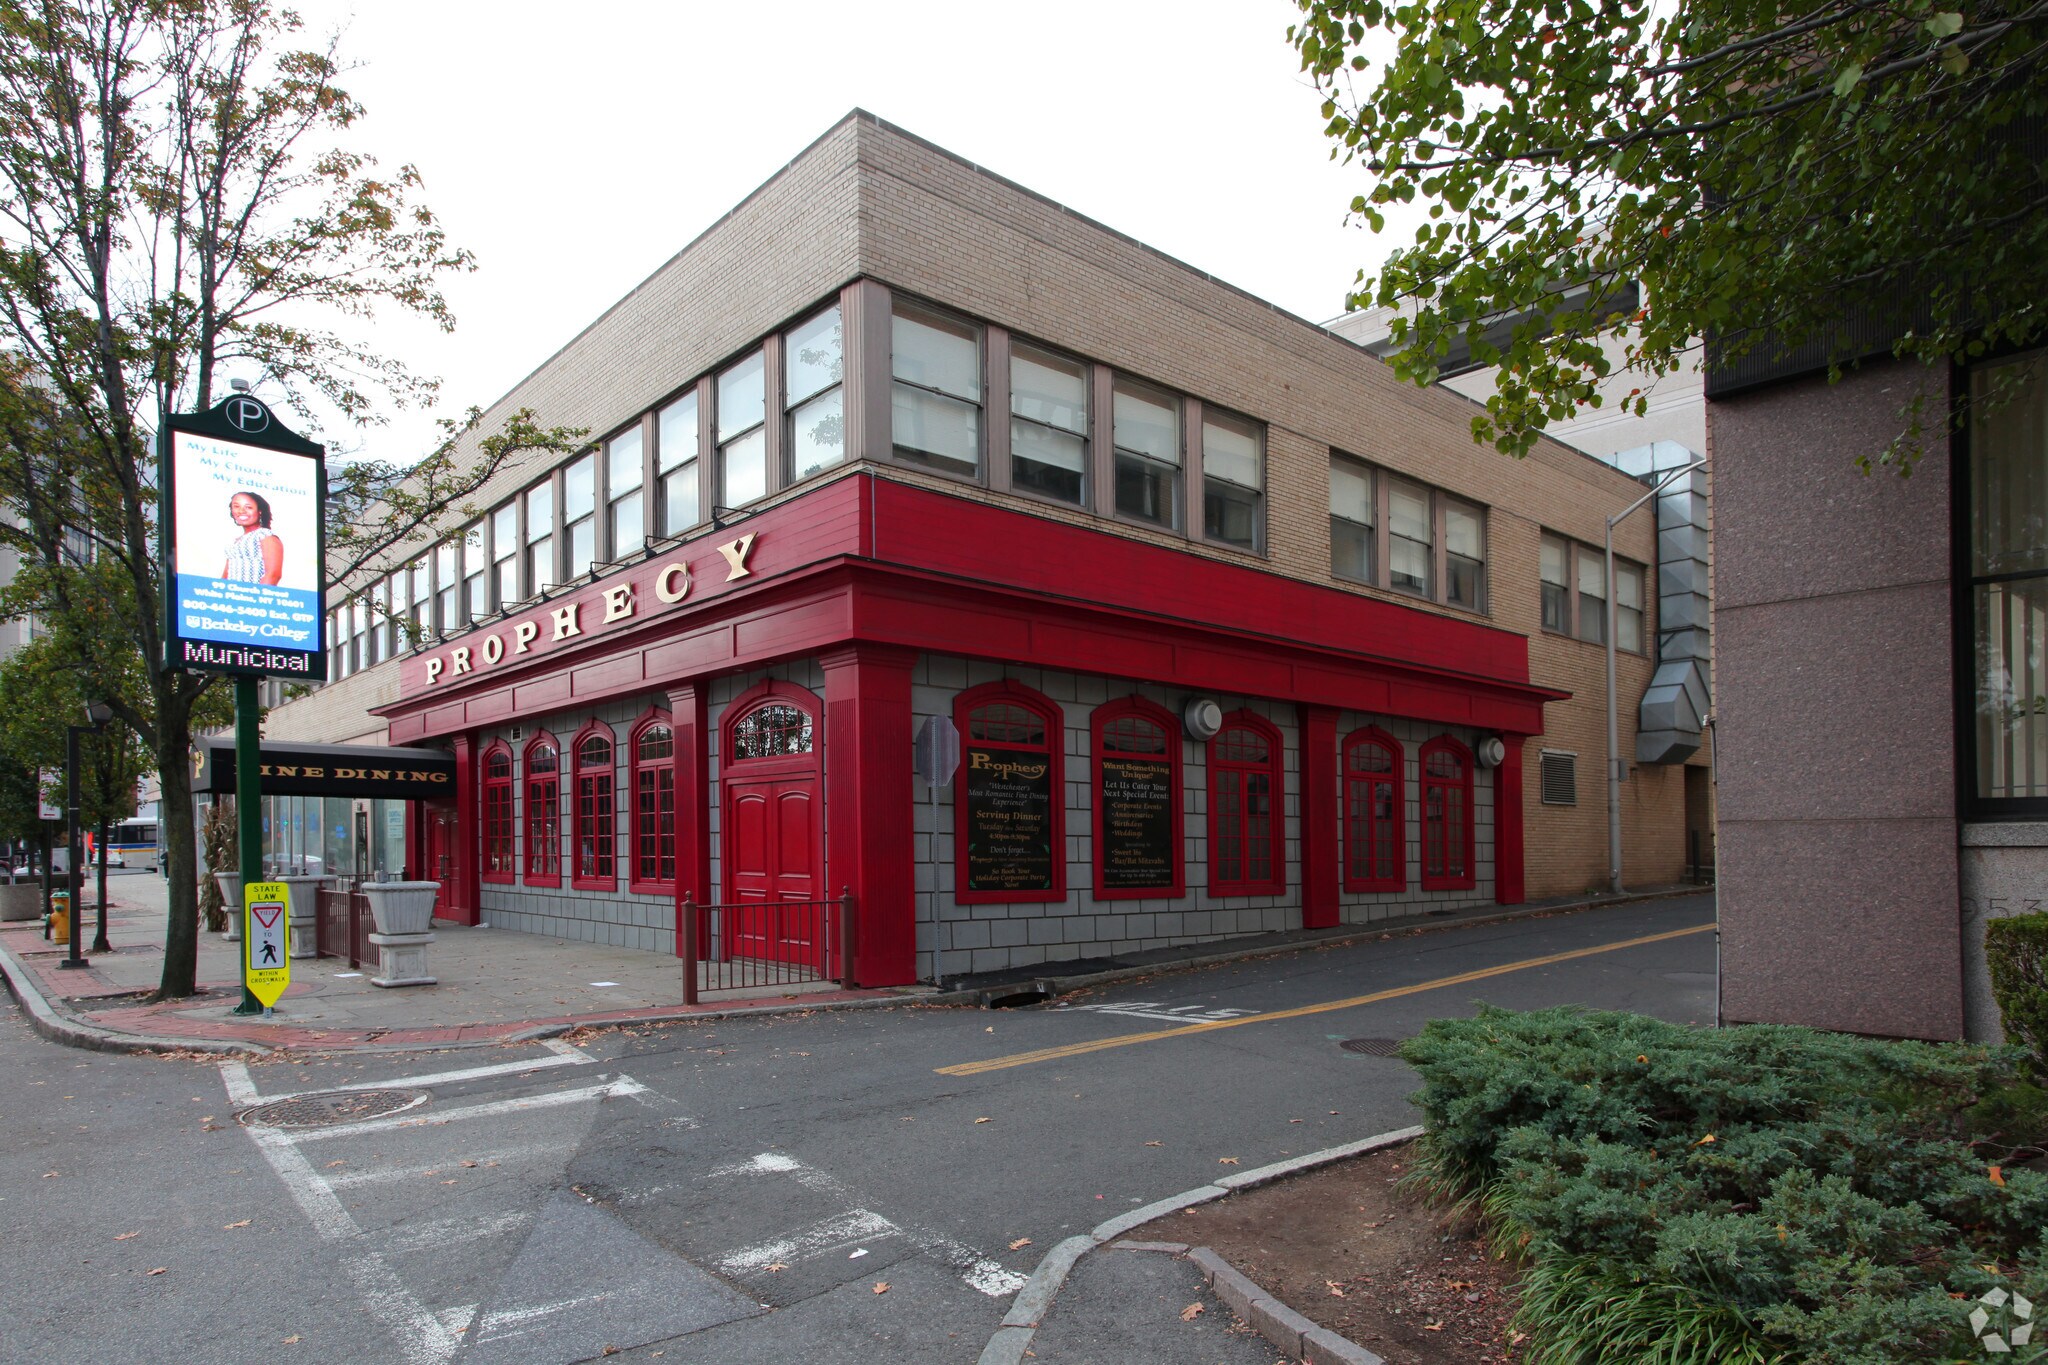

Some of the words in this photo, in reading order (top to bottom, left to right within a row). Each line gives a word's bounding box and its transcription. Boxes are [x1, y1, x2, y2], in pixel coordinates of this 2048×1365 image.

[239, 400, 262, 429] P
[187, 441, 206, 453] My
[212, 446, 239, 458] Life
[200, 456, 219, 468] My
[225, 462, 273, 476] Choice
[212, 472, 232, 483] My
[237, 477, 308, 496] Education
[194, 588, 223, 598] White
[259, 596, 274, 605] NY
[227, 583, 260, 594] Church
[262, 588, 289, 598] Street
[425, 531, 759, 685] PROPHECY
[201, 617, 259, 637] Berkeley
[260, 624, 310, 641] College
[185, 642, 309, 671] Municipal
[233, 764, 324, 778] INE
[334, 768, 448, 782] DINING
[970, 752, 1047, 780] Prophecy
[1103, 761, 1125, 770] Want
[1126, 763, 1170, 774] Something
[1121, 771, 1154, 780] Unique?
[1103, 789, 1120, 797] Next
[1122, 790, 1148, 800] Special
[1149, 791, 1169, 800] Event:
[1105, 781, 1118, 789] Let
[1119, 781, 1130, 789] Us
[1132, 782, 1151, 790] Cater
[1152, 783, 1167, 791] Your
[968, 789, 983, 797] Most
[985, 790, 1014, 799] Romantic
[1015, 791, 1028, 799] Fine
[1029, 792, 1049, 801] Dining
[976, 810, 1010, 823] Serving
[1013, 811, 1042, 821] Dinner
[978, 823, 1004, 833] Tuesday
